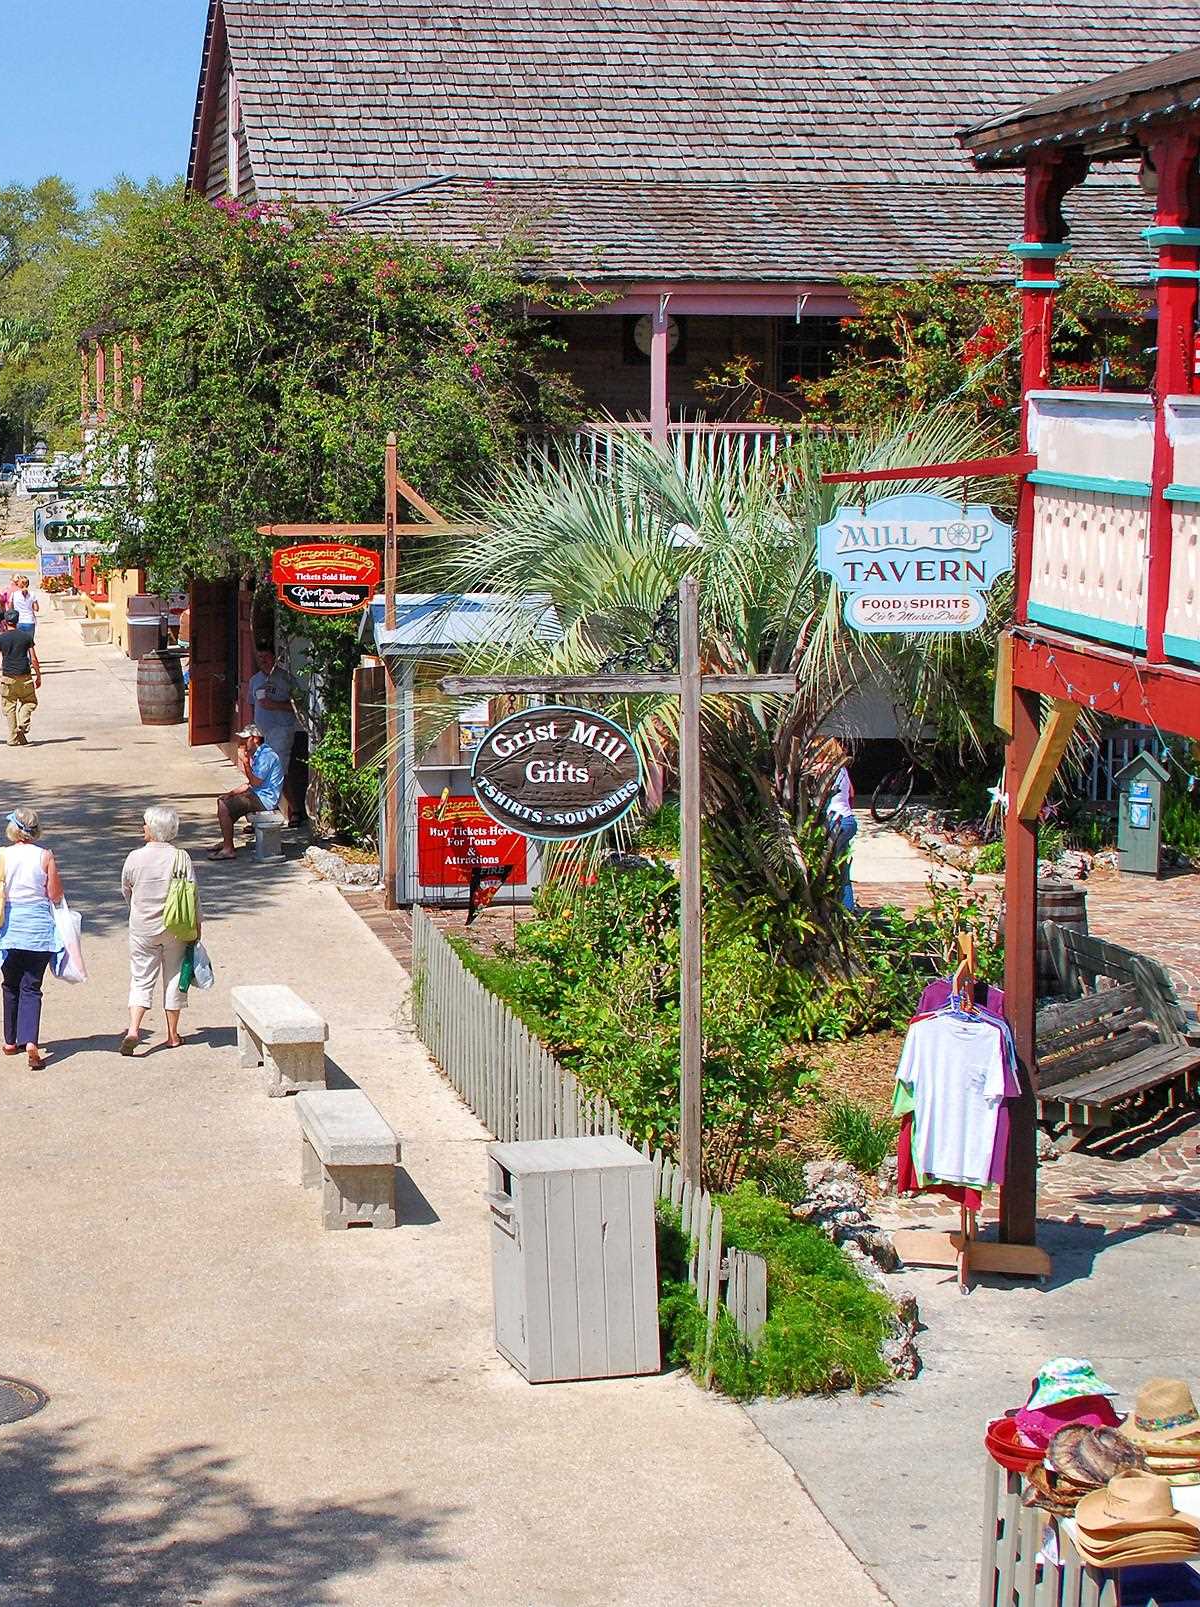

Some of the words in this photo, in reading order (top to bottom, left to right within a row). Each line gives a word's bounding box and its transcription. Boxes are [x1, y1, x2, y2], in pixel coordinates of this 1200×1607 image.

[843, 524, 916, 547] MILL
[929, 523, 989, 546] TOP
[295, 573, 321, 581] Tickets
[322, 573, 338, 581] Sold
[340, 573, 358, 581] Here
[843, 560, 988, 583] TAVERN
[862, 600, 901, 609] FOOD
[910, 599, 970, 609] SPIRITS
[899, 610, 934, 622] Music
[934, 610, 971, 624] Daily
[491, 720, 560, 758] Grist
[568, 720, 629, 764] Mill
[525, 760, 590, 784] Gifts
[554, 780, 639, 825] SOUVENIRS
[429, 827, 449, 838] Buy
[454, 826, 487, 836] Tickets
[447, 838, 464, 846] For
[468, 836, 497, 846] Tours
[467, 847, 476, 856] &
[444, 855, 500, 865] Attractions
